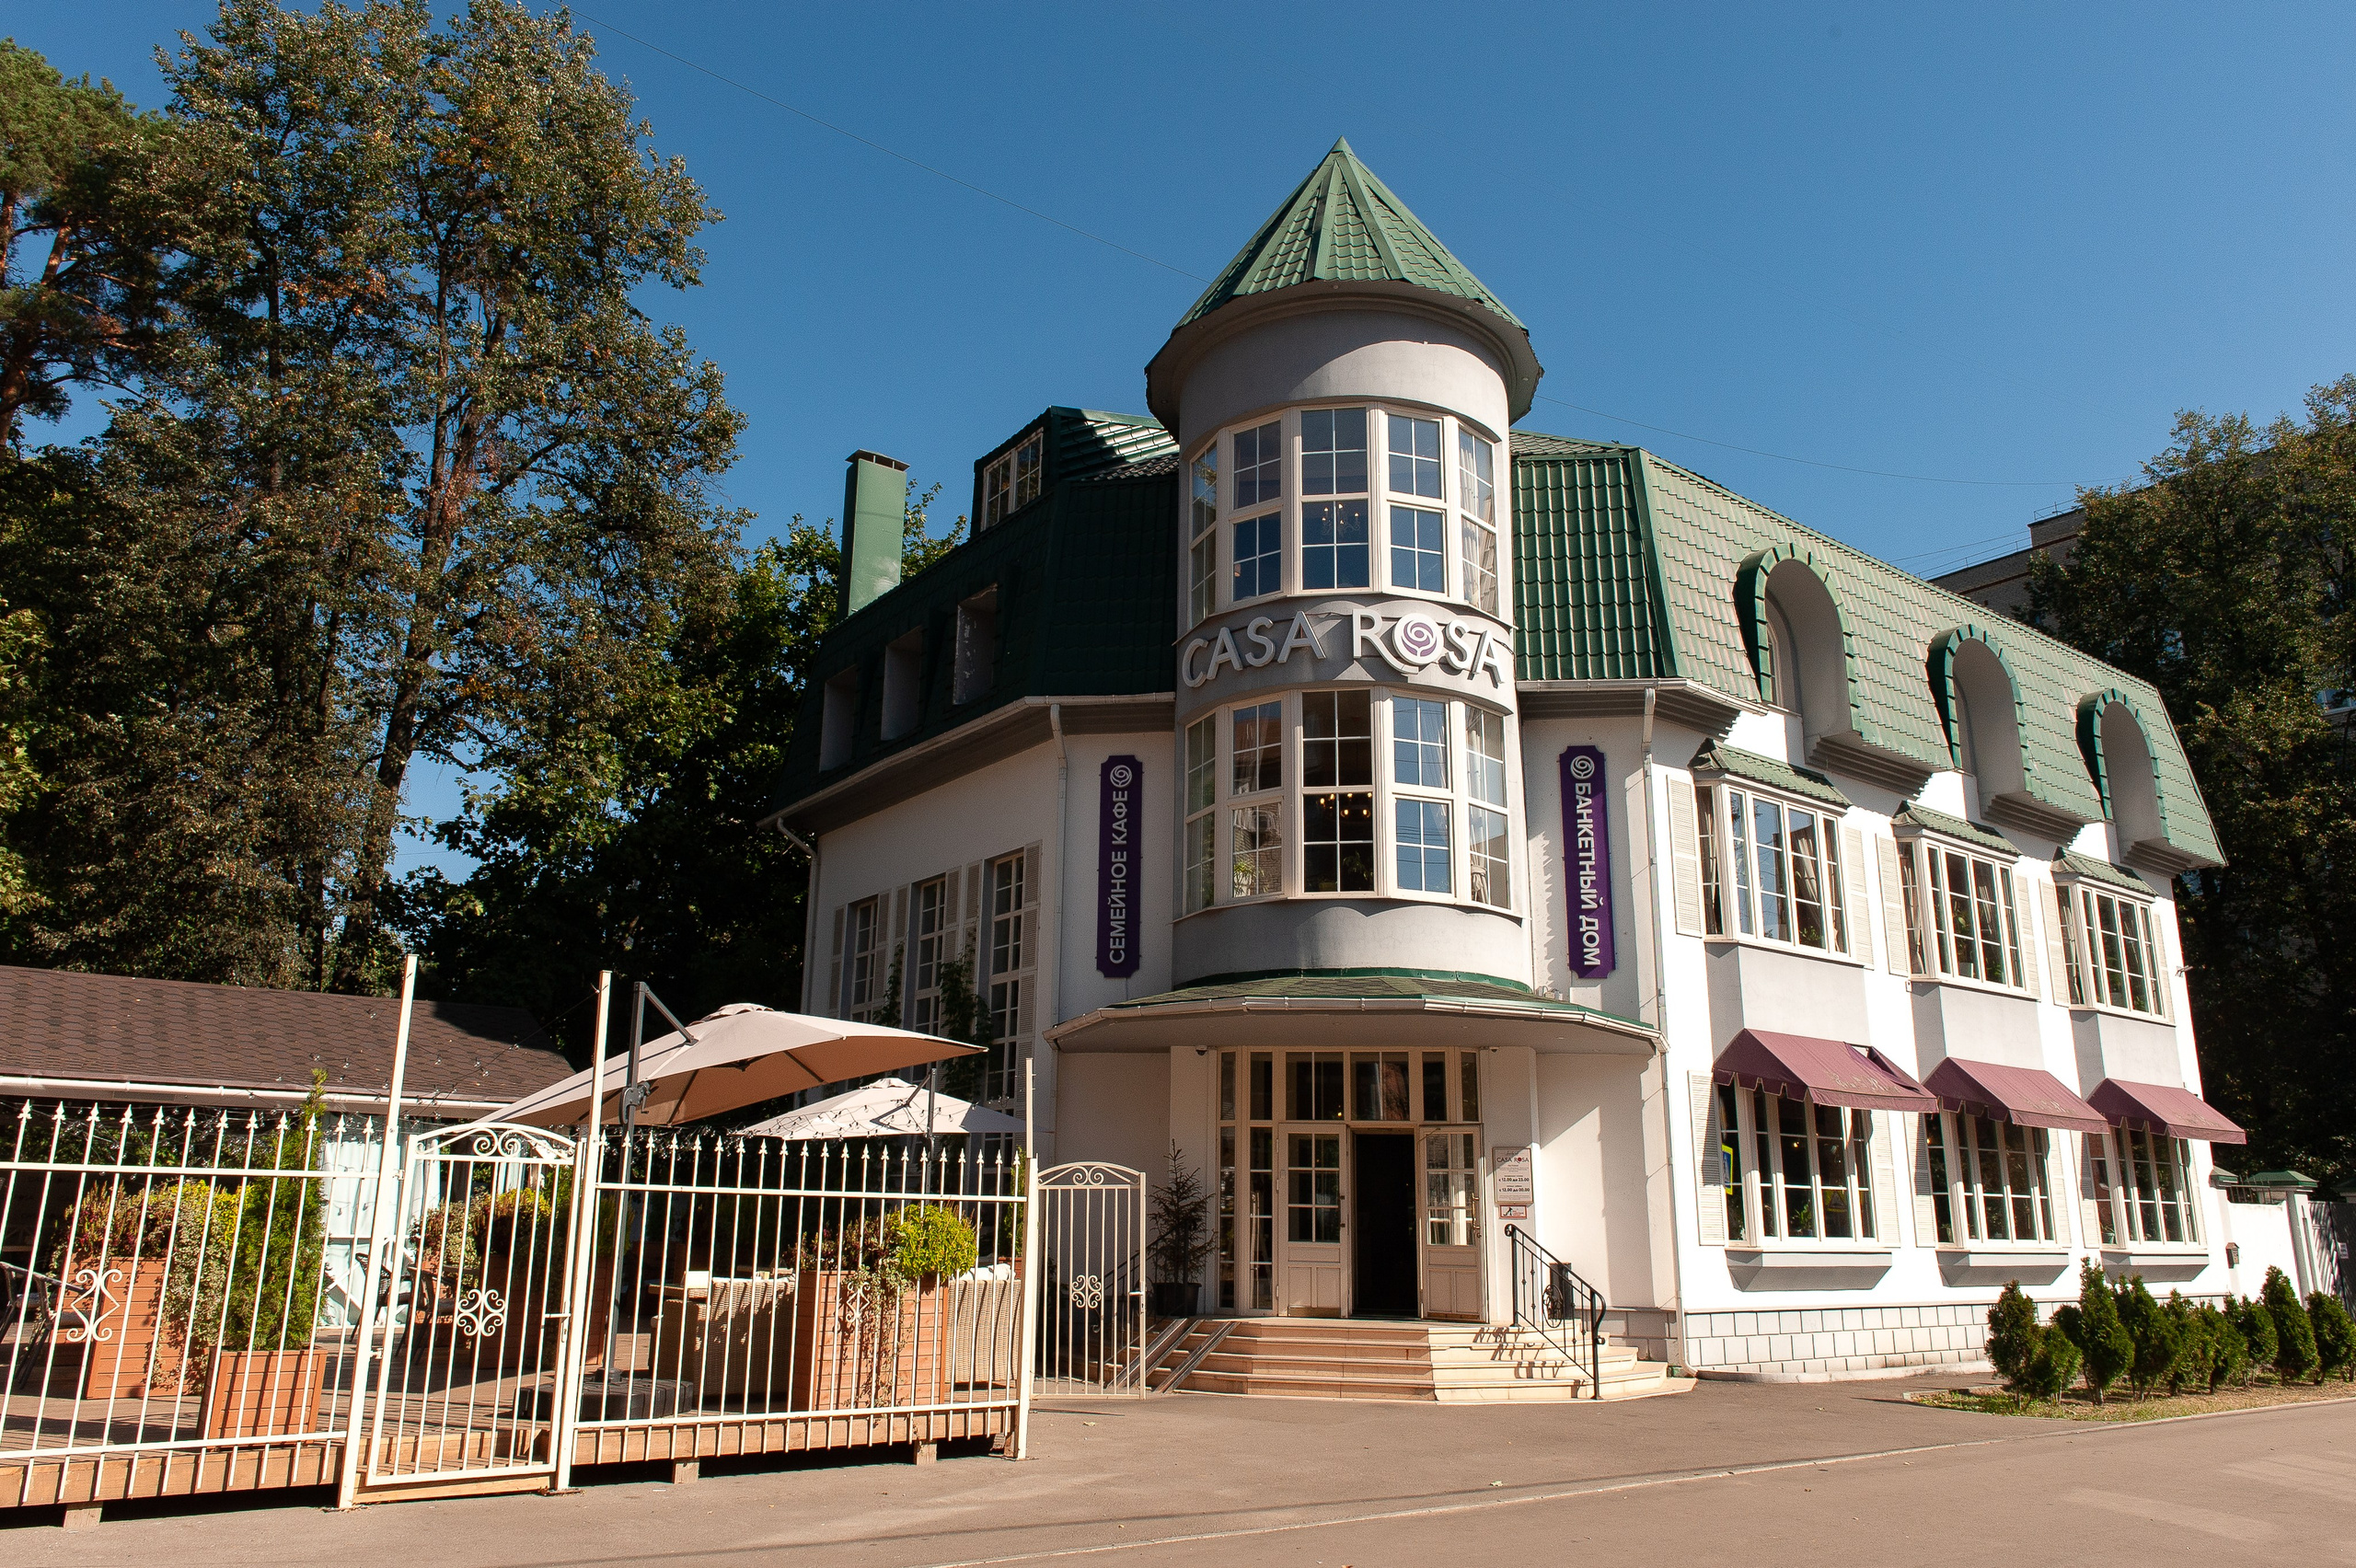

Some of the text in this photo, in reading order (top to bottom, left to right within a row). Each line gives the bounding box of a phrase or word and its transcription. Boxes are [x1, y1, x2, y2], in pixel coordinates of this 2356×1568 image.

[1182, 608, 1505, 688] CASA ROSA
[1107, 790, 1128, 964] СЕМЕЙНОЕ КАФЕ
[1575, 782, 1604, 966] БАНКЕТНЫЙ ДОМ
